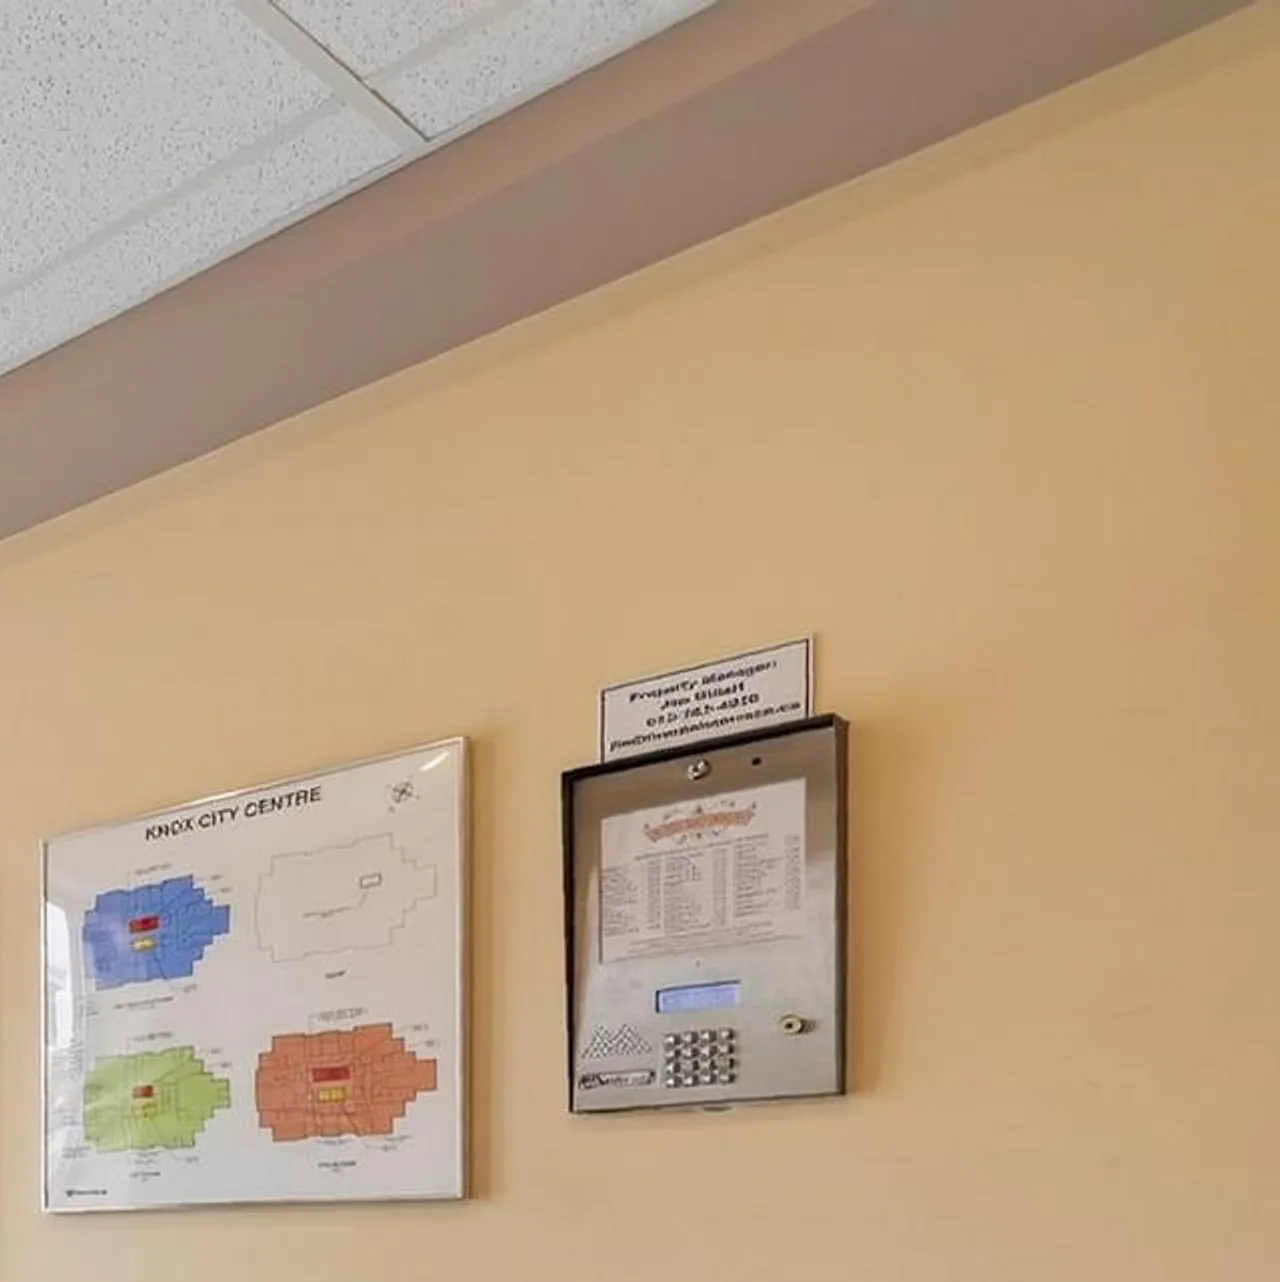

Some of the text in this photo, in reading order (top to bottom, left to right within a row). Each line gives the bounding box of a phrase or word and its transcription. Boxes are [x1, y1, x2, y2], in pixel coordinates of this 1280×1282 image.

[145, 786, 322, 841] KNOX CITY CENTRE
